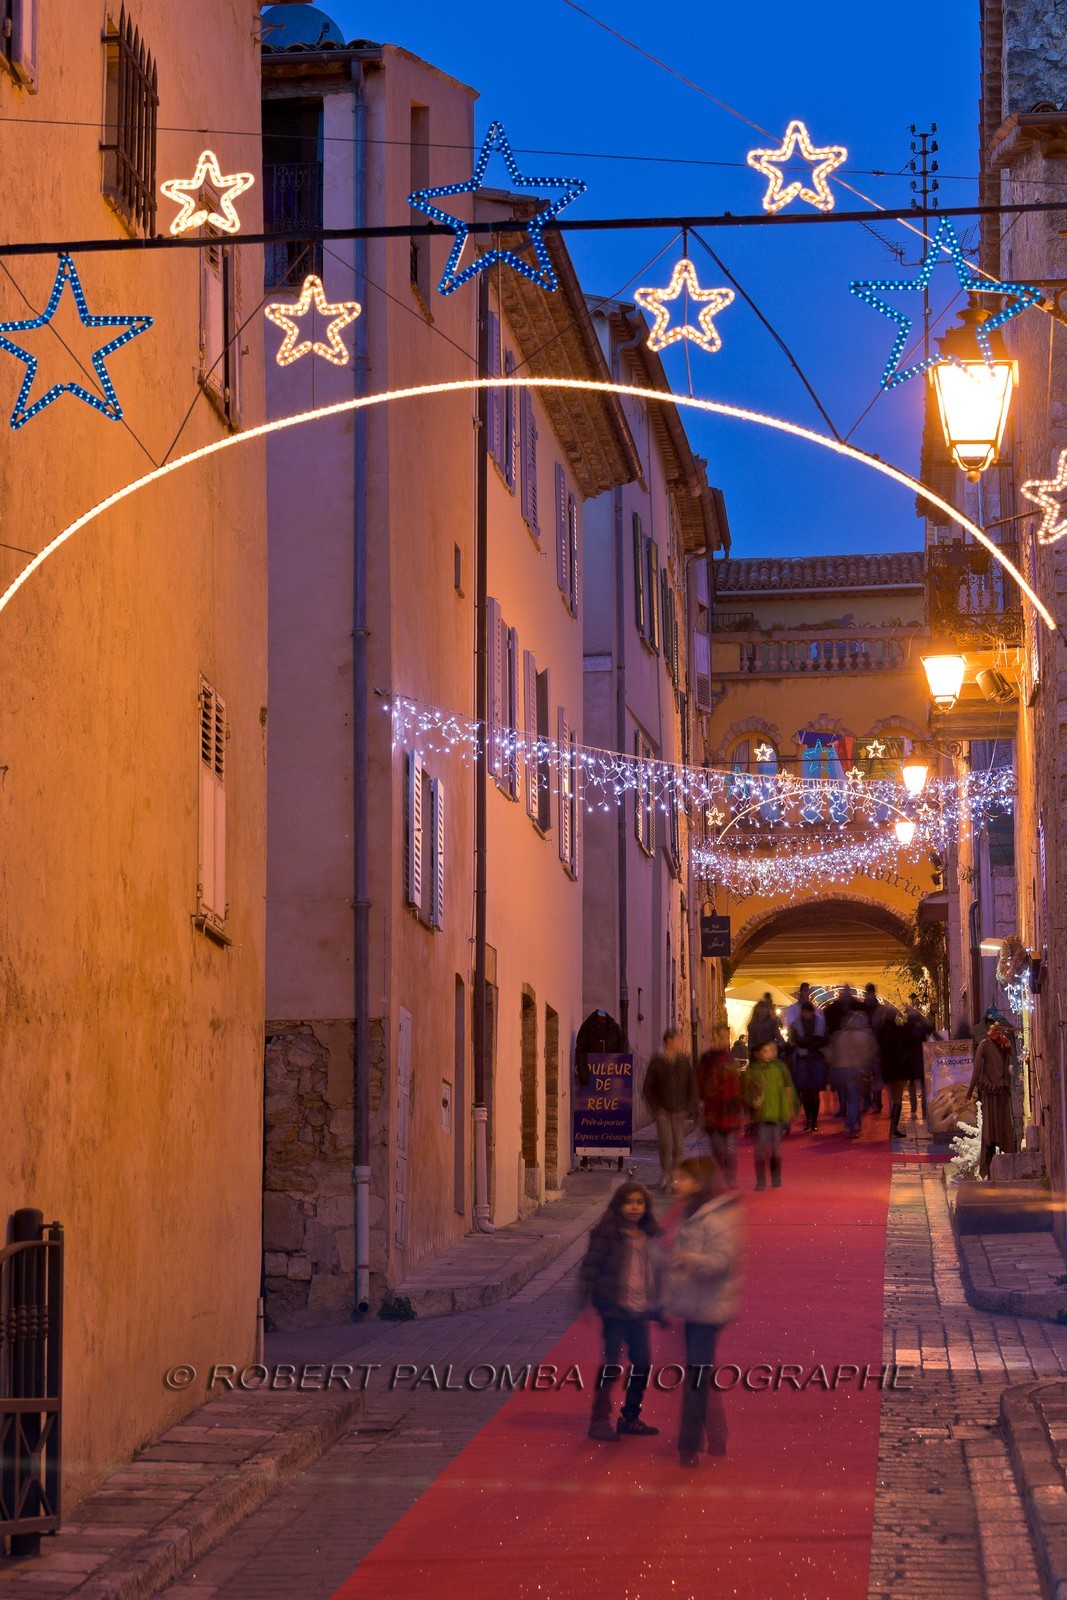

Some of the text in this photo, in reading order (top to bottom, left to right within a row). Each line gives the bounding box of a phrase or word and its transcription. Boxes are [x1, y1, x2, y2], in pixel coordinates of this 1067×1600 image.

[574, 1063, 632, 1076] ULEUR
[595, 1078, 611, 1091] DE
[574, 1132, 600, 1142] Espace
